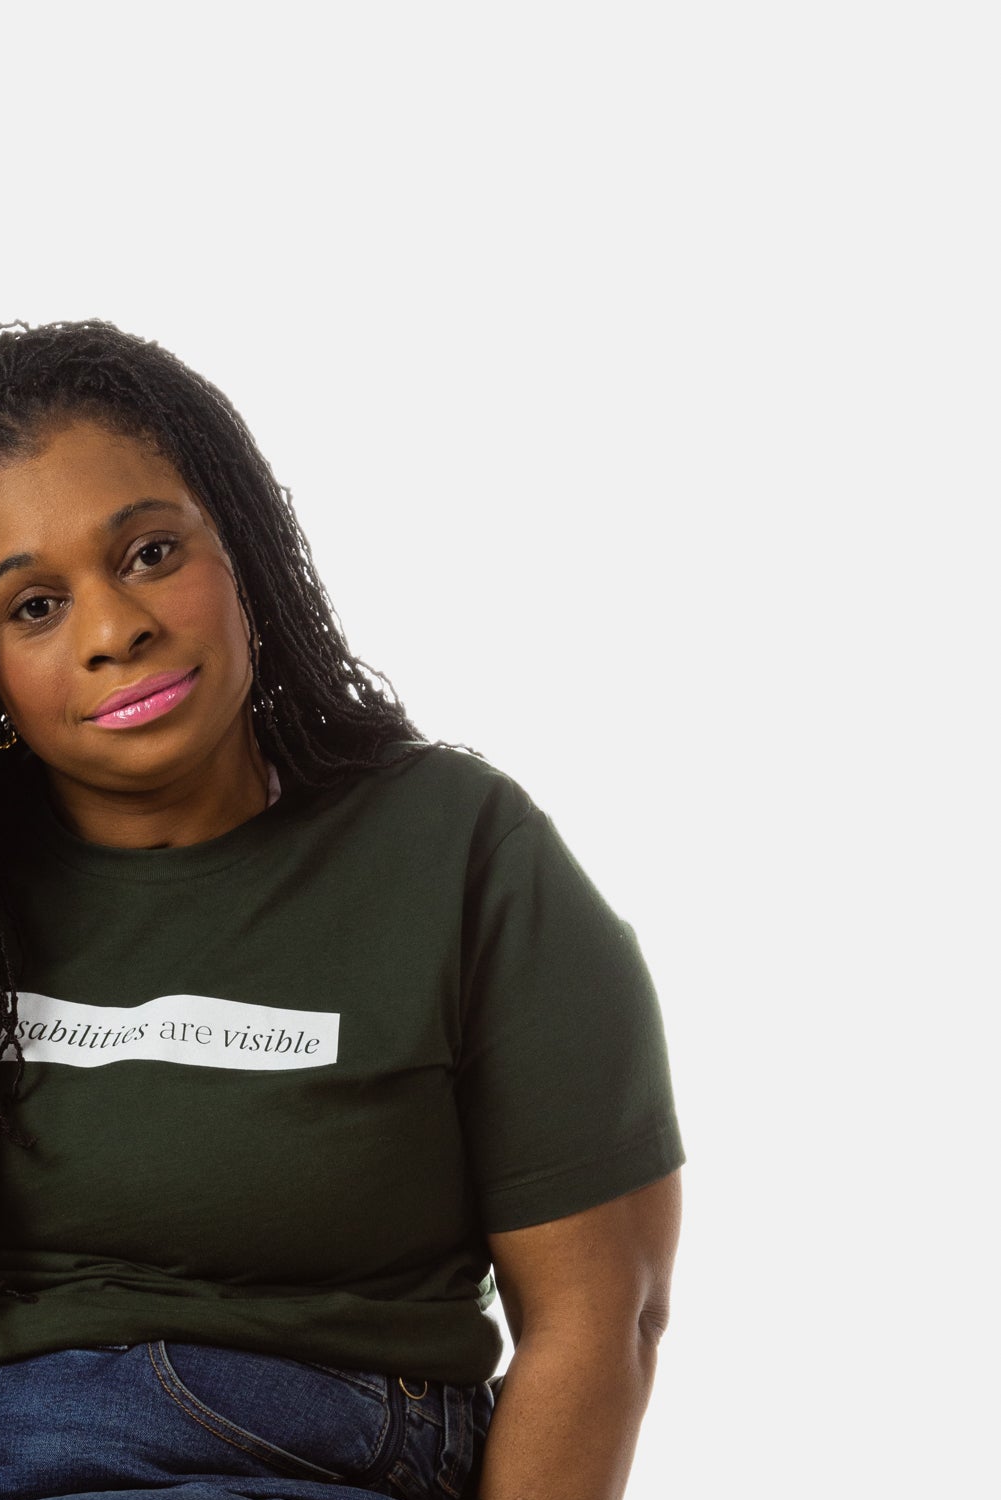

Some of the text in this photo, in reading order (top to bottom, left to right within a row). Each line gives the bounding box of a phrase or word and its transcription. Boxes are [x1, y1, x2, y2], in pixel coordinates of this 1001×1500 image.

[3, 1019, 321, 1055] sabilities are visible
